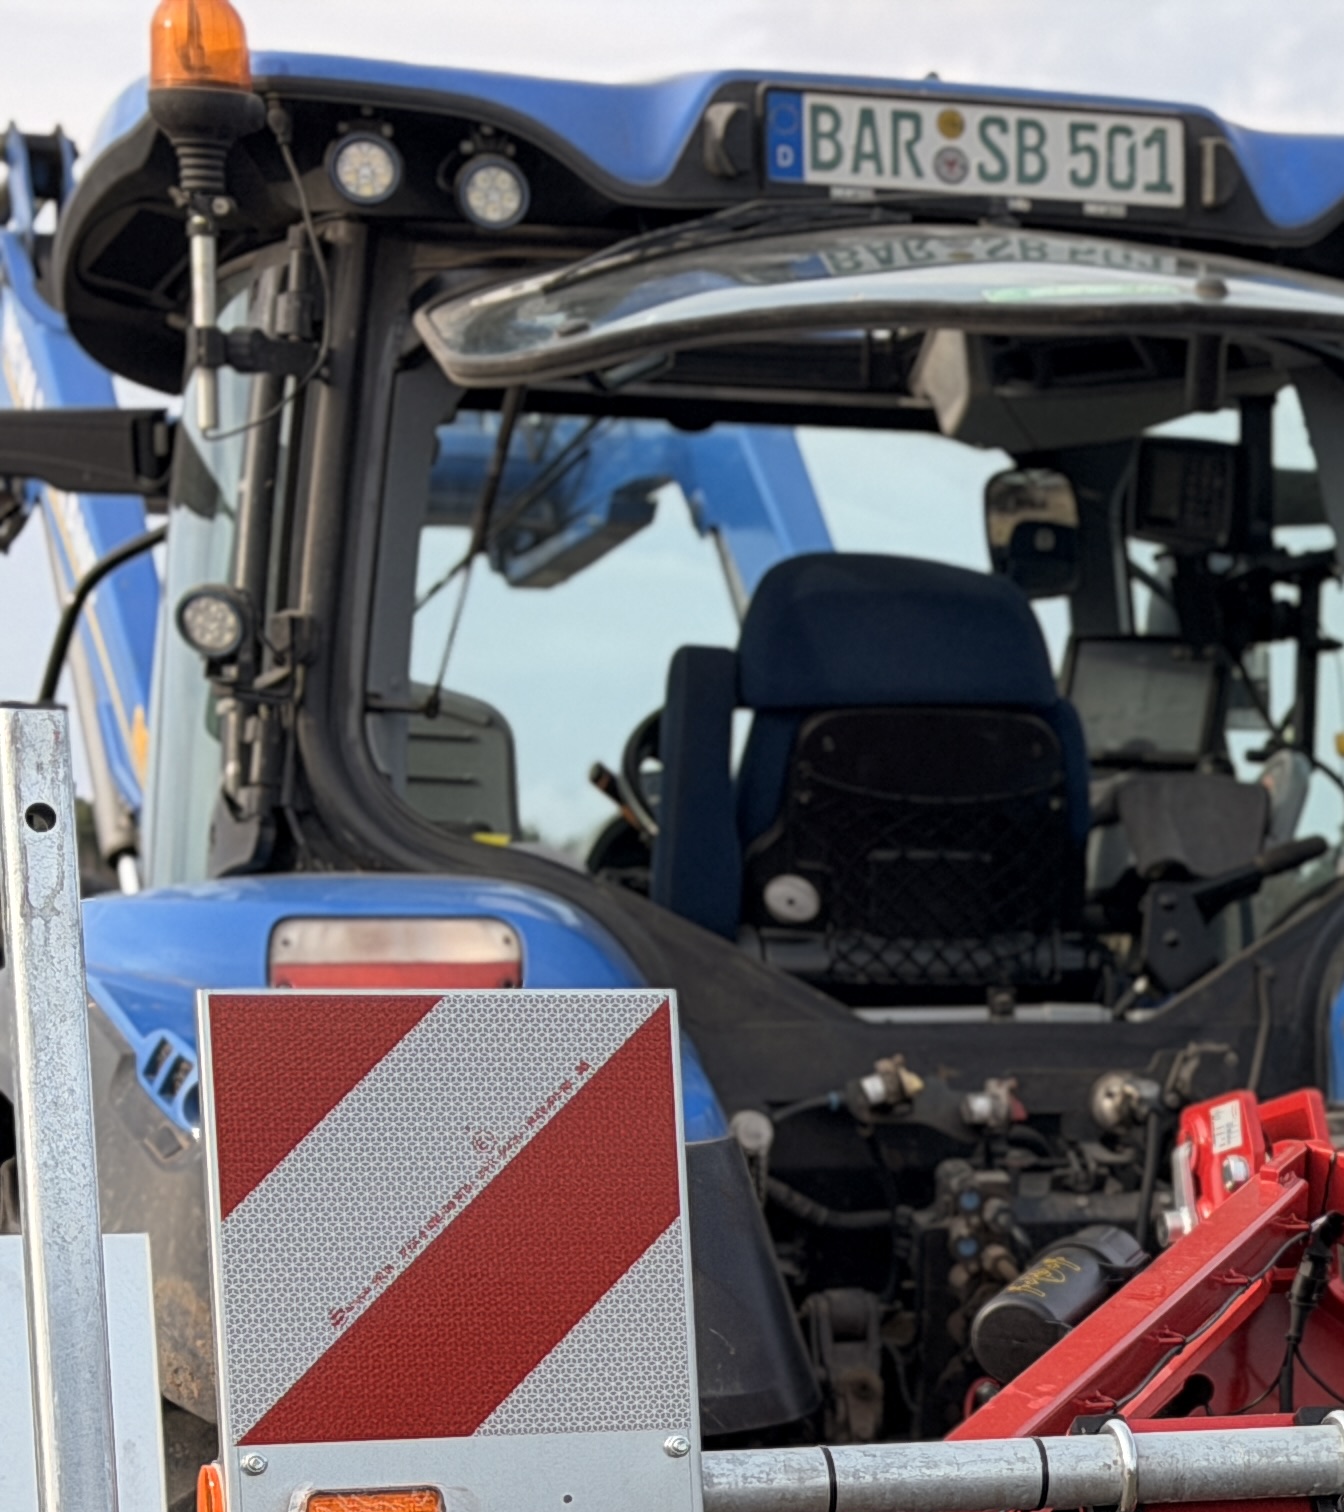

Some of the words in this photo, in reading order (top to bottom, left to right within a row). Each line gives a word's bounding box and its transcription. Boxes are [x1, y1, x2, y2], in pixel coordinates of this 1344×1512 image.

[775, 144, 795, 168] D
[809, 103, 924, 179] BAR
[977, 116, 1049, 186] SB
[1068, 121, 1174, 194] 501
